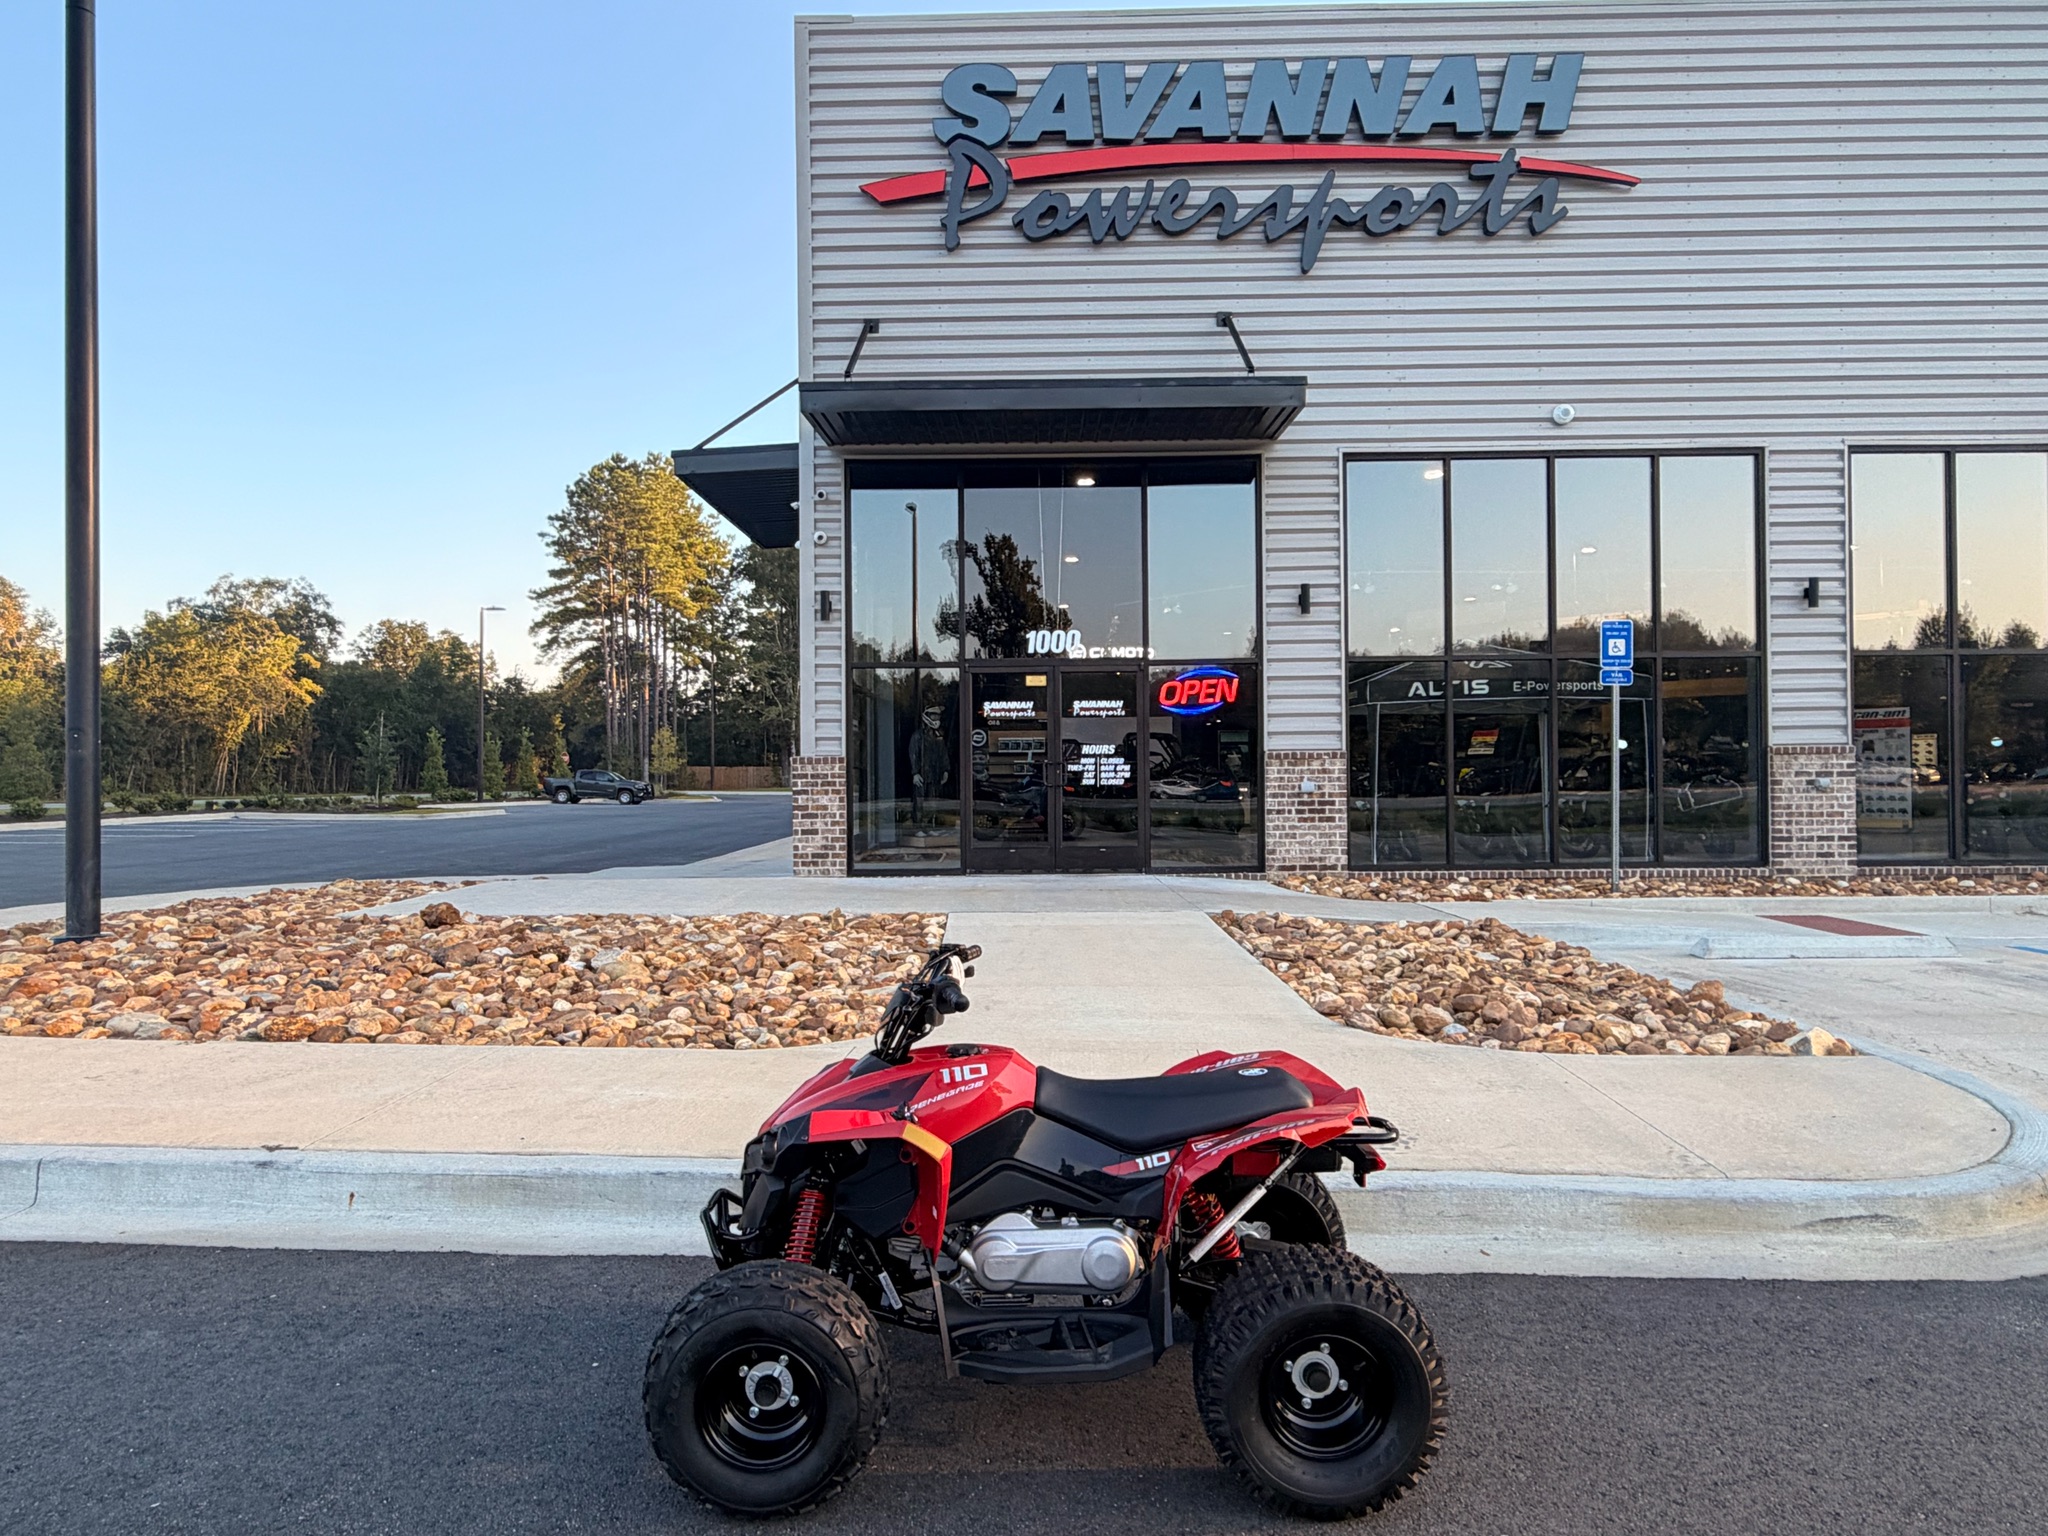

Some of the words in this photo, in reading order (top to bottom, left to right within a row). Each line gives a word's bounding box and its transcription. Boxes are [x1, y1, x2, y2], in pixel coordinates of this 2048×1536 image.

[933, 52, 1585, 147] SAVANNAH
[940, 136, 1570, 274] Powersports
[1026, 629, 1081, 654] 1000
[1159, 678, 1240, 706] OPEN
[983, 701, 1034, 709] SAVANNAH
[1073, 700, 1124, 708] SAVANNAH
[983, 707, 1036, 720] Powersports
[1073, 706, 1126, 719] Powersports
[1081, 744, 1116, 755] HOURS
[1080, 757, 1096, 765] MON
[940, 1063, 988, 1084] 110
[1135, 1151, 1171, 1171] 110
